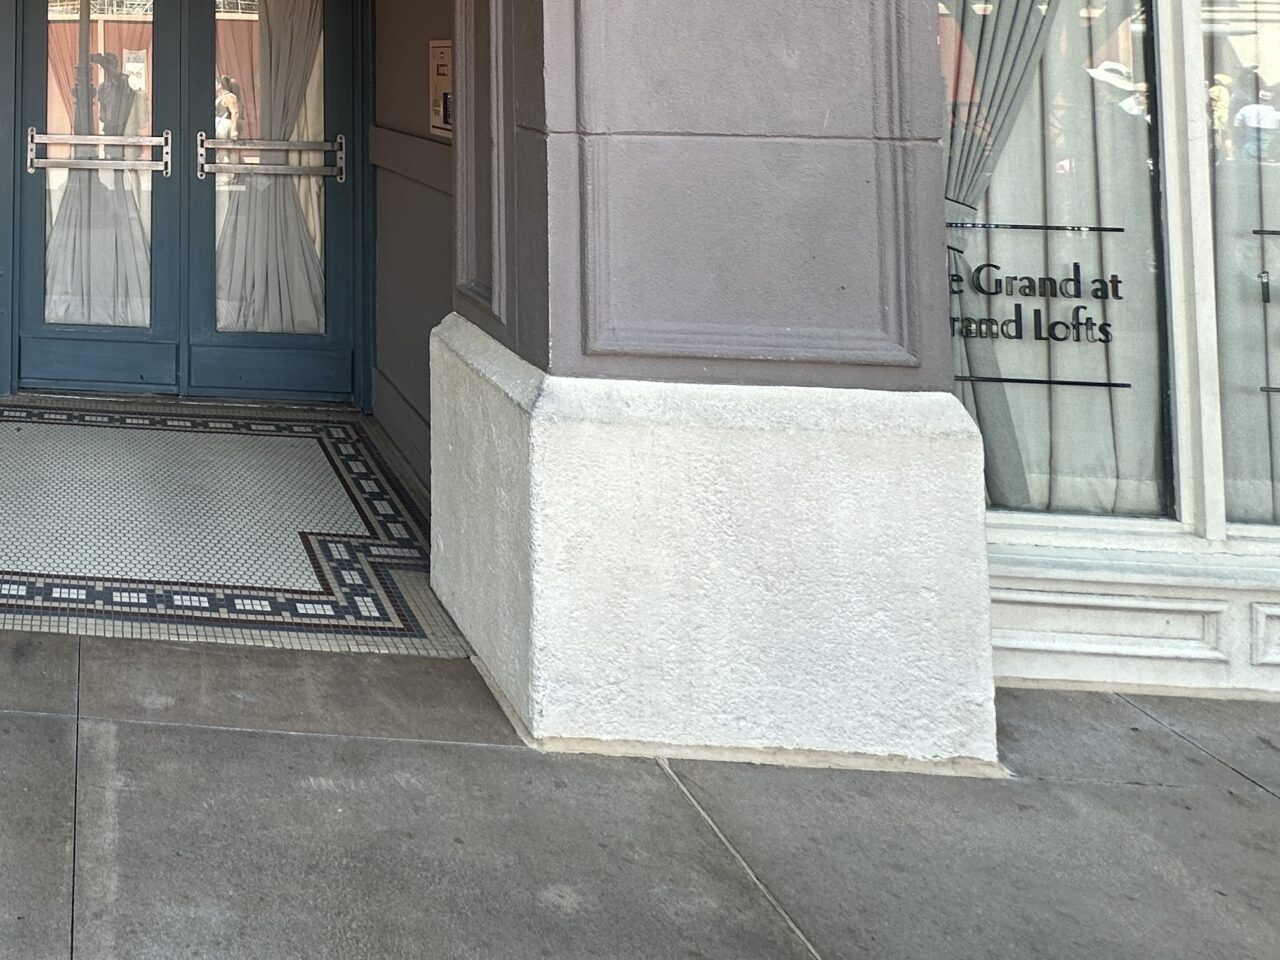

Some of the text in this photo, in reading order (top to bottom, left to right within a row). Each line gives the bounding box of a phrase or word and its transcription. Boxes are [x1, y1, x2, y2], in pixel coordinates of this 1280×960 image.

[972, 262, 1081, 299] Grand
[1091, 274, 1123, 300] at
[949, 303, 1113, 344] rand Lofts
